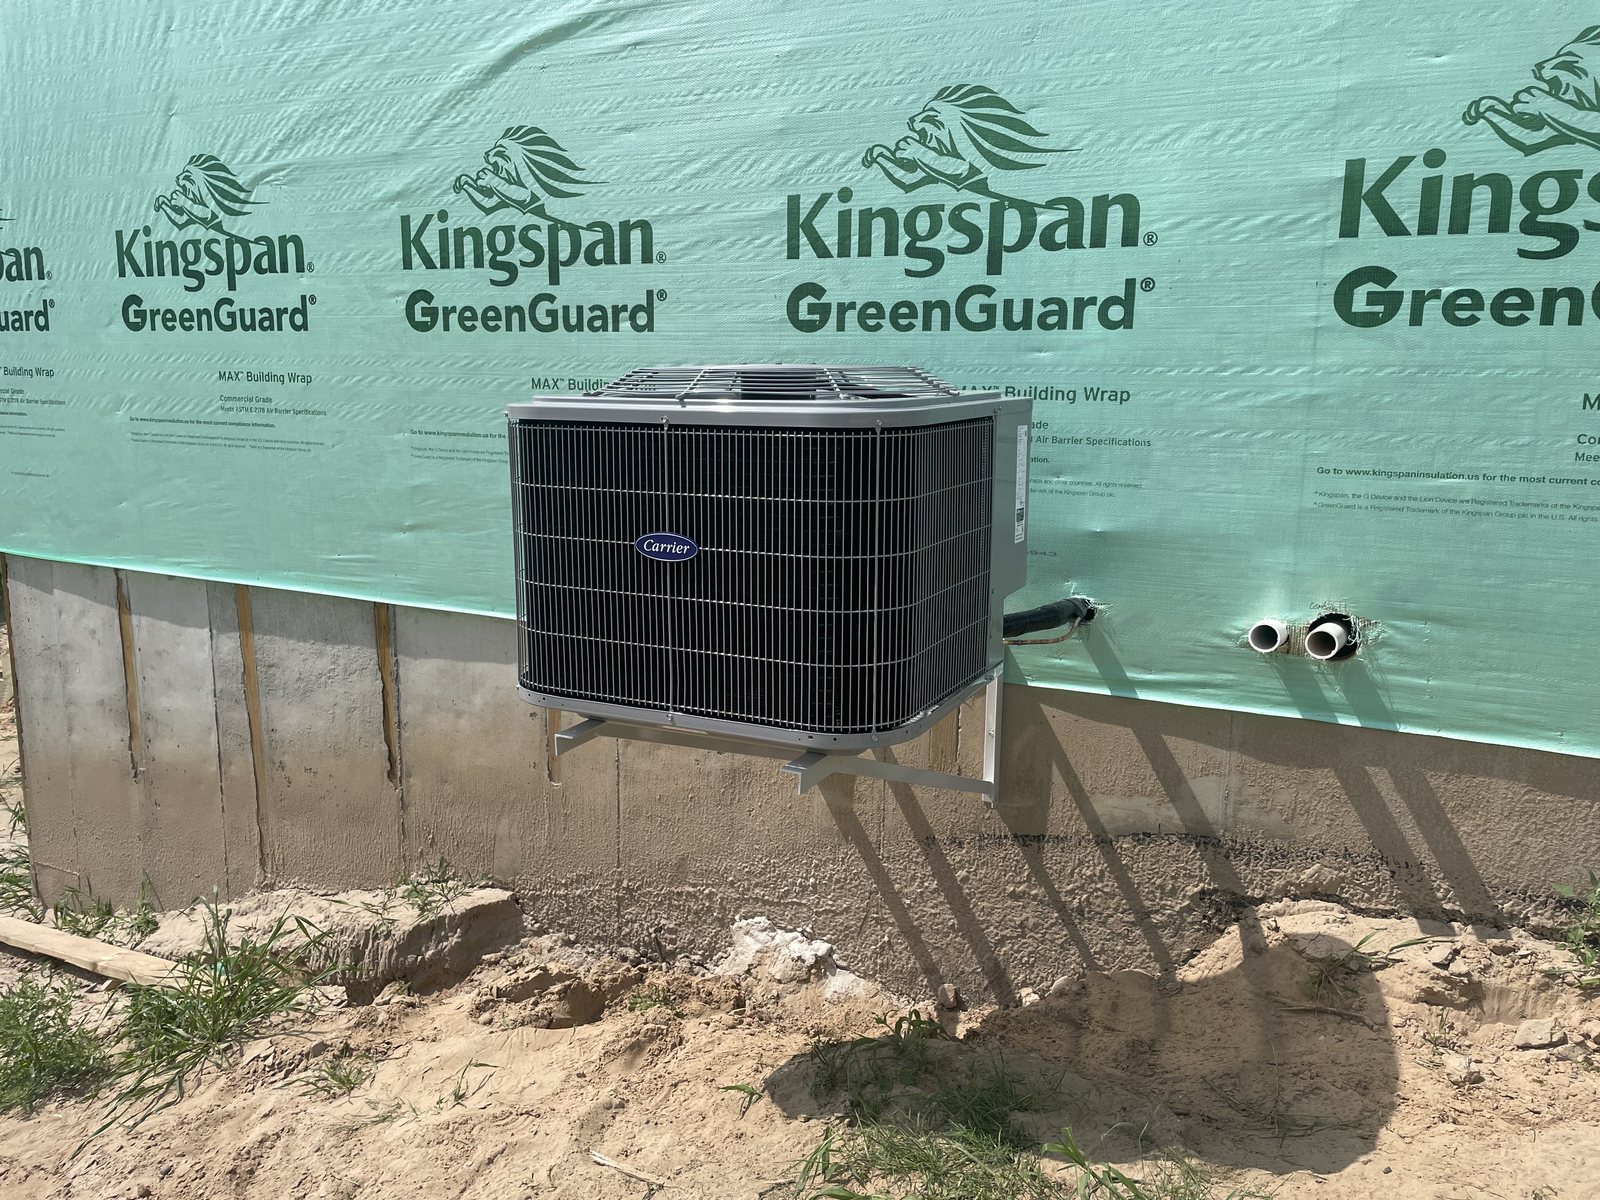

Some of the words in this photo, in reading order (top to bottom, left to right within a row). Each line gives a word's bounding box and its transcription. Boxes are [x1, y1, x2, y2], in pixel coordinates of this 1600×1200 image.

[1333, 265, 1600, 328] Green
[4, 366, 33, 378] Building
[35, 367, 55, 379] Wrap
[246, 371, 285, 385] Building
[288, 372, 313, 386] Wrap
[220, 394, 254, 403] Commercial
[255, 395, 273, 404] Grade
[1005, 385, 1077, 404] Building
[1084, 387, 1131, 405] Wrap
[1035, 435, 1049, 444] Air
[1051, 435, 1083, 445] Barrier
[1086, 436, 1151, 447] Specifications
[1317, 466, 1331, 475] Go
[1333, 467, 1343, 475] to
[1345, 468, 1480, 480] www.kingspaninsulation.us
[1482, 473, 1497, 481] for
[1500, 473, 1516, 482] the
[1519, 475, 1546, 484] most
[1548, 477, 1588, 485] current
[643, 539, 690, 554] Carrier
